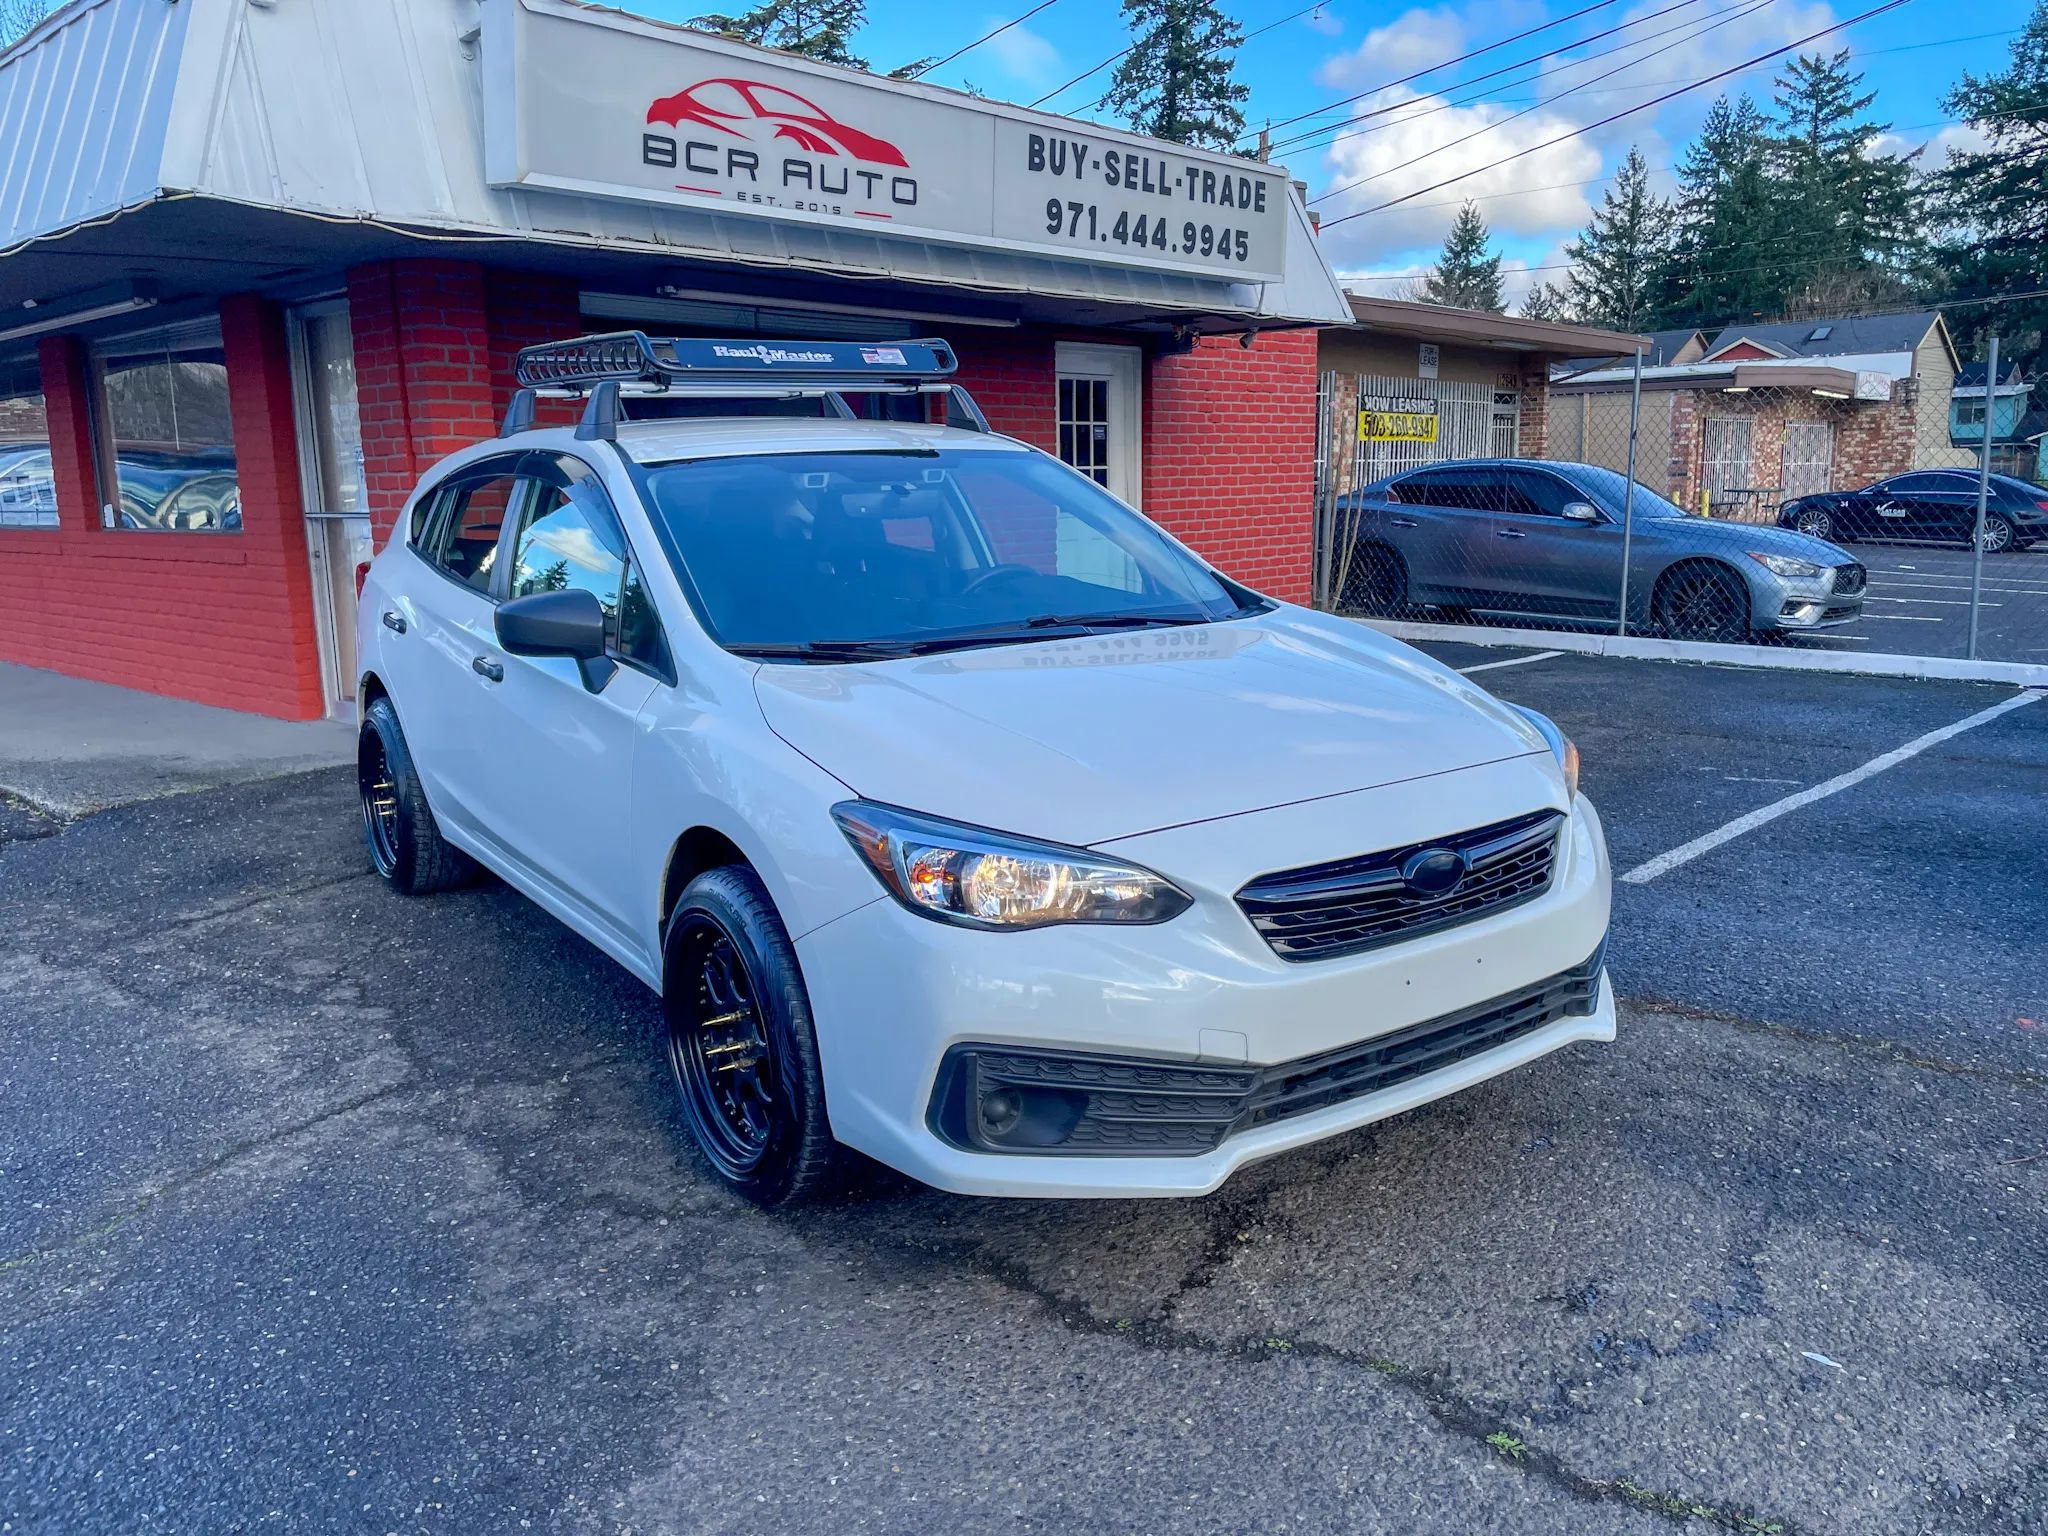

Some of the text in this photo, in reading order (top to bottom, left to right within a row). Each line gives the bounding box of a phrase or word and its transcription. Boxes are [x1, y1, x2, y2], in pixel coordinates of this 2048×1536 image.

[643, 133, 917, 206] BCR AUTO
[1028, 133, 1266, 213] BUY-SELL-TRADE
[738, 191, 841, 215] EST. 2015
[1046, 198, 1249, 262] 971.444.9945
[713, 346, 832, 362] Haul Master
[1364, 396, 1435, 414] NOW LEASING
